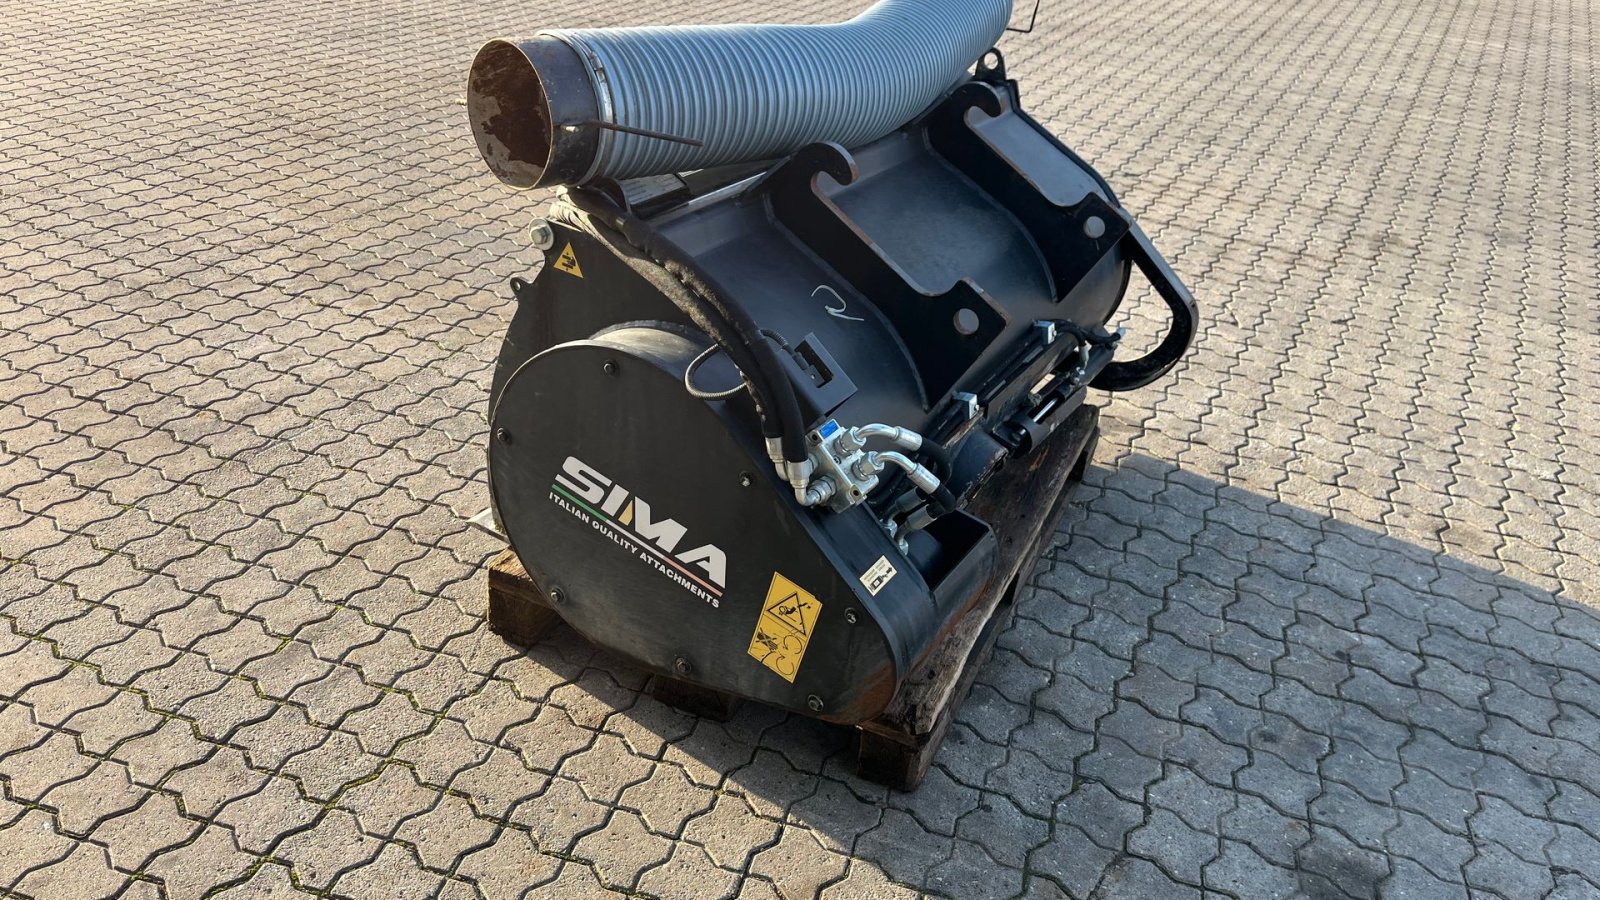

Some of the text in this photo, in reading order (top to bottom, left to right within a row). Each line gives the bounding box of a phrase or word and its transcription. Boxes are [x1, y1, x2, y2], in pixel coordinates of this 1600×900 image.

[549, 492, 720, 609] ITALIAN QUALITY ATTACHMENTS
[555, 456, 726, 588] SIMA
